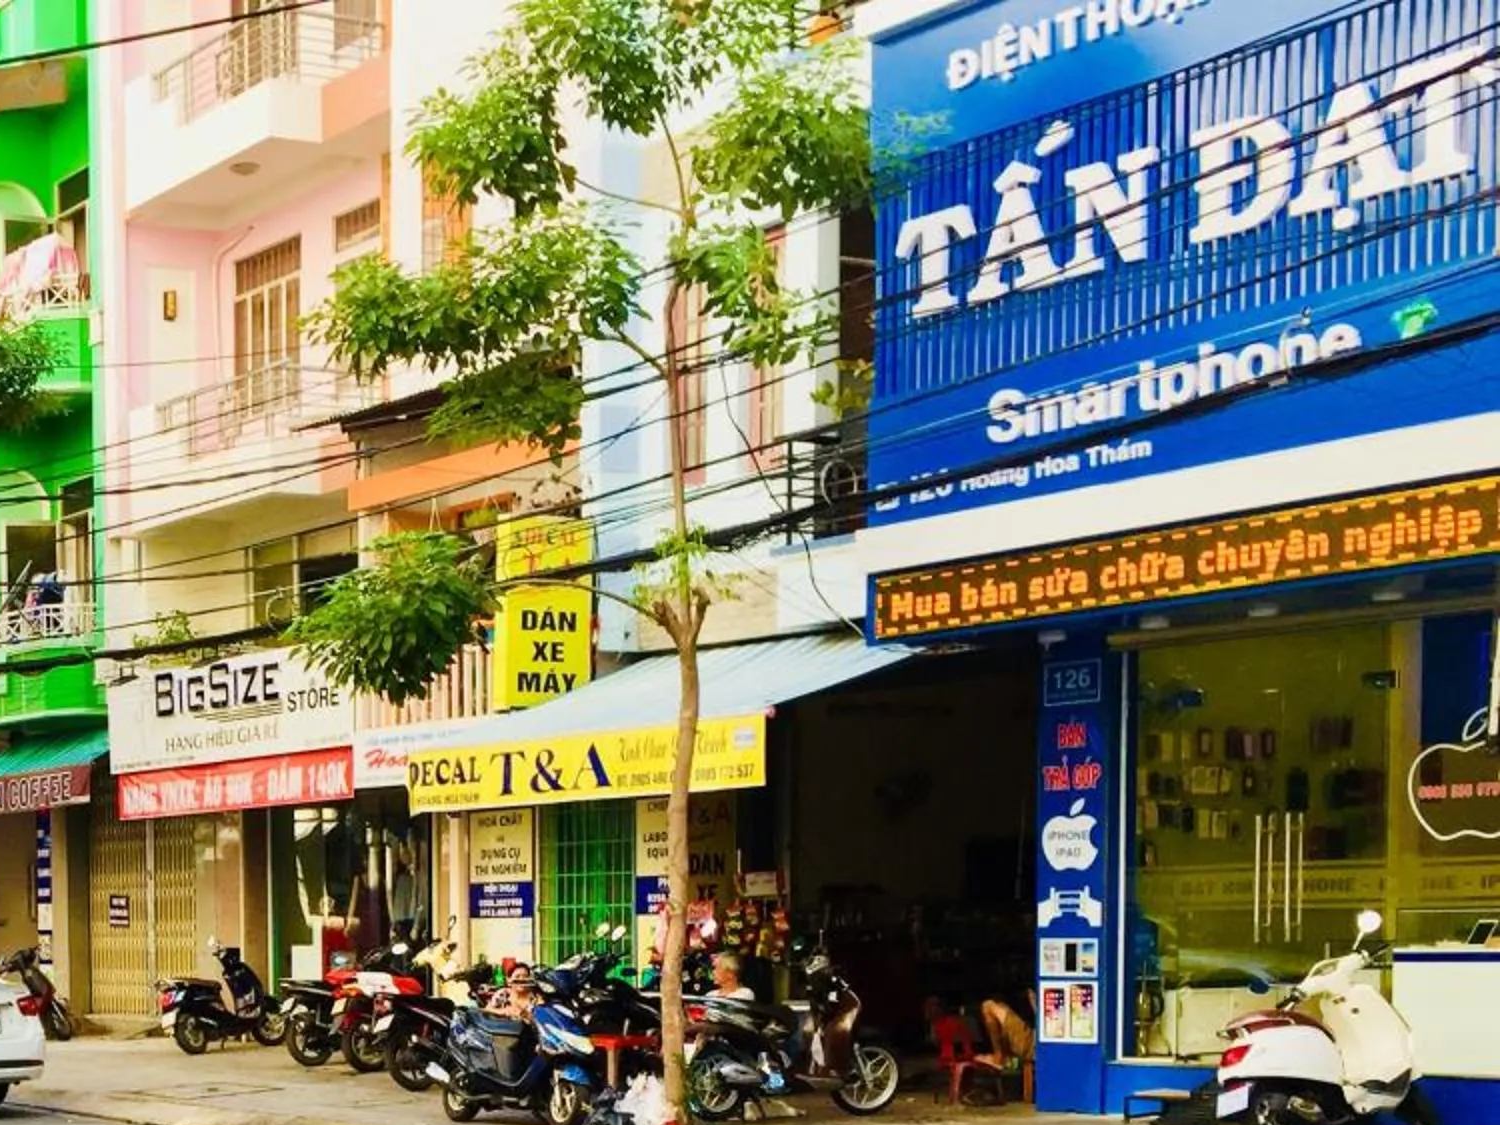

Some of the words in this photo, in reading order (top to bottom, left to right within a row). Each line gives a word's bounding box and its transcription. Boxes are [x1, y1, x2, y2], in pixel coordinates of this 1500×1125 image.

[946, 17, 1053, 90] ĐIỆN
[895, 119, 1160, 319] TẤN
[1189, 43, 1500, 244] ĐẠT
[986, 323, 1363, 443] Smartphone
[1085, 438, 1153, 468] Thám
[891, 586, 950, 621] Mua
[960, 578, 1017, 614] bán
[1029, 565, 1089, 601] sửa
[1100, 552, 1186, 591] chữa
[1197, 529, 1329, 582] chuyên
[1343, 503, 1483, 553] nghiệp
[520, 606, 578, 632] DÁN
[531, 641, 565, 663] XE
[516, 668, 577, 694] MÁY
[1053, 668, 1092, 690] 126
[287, 687, 340, 713] STORE
[8, 770, 73, 811] COFFEE
[307, 759, 350, 800] 140K
